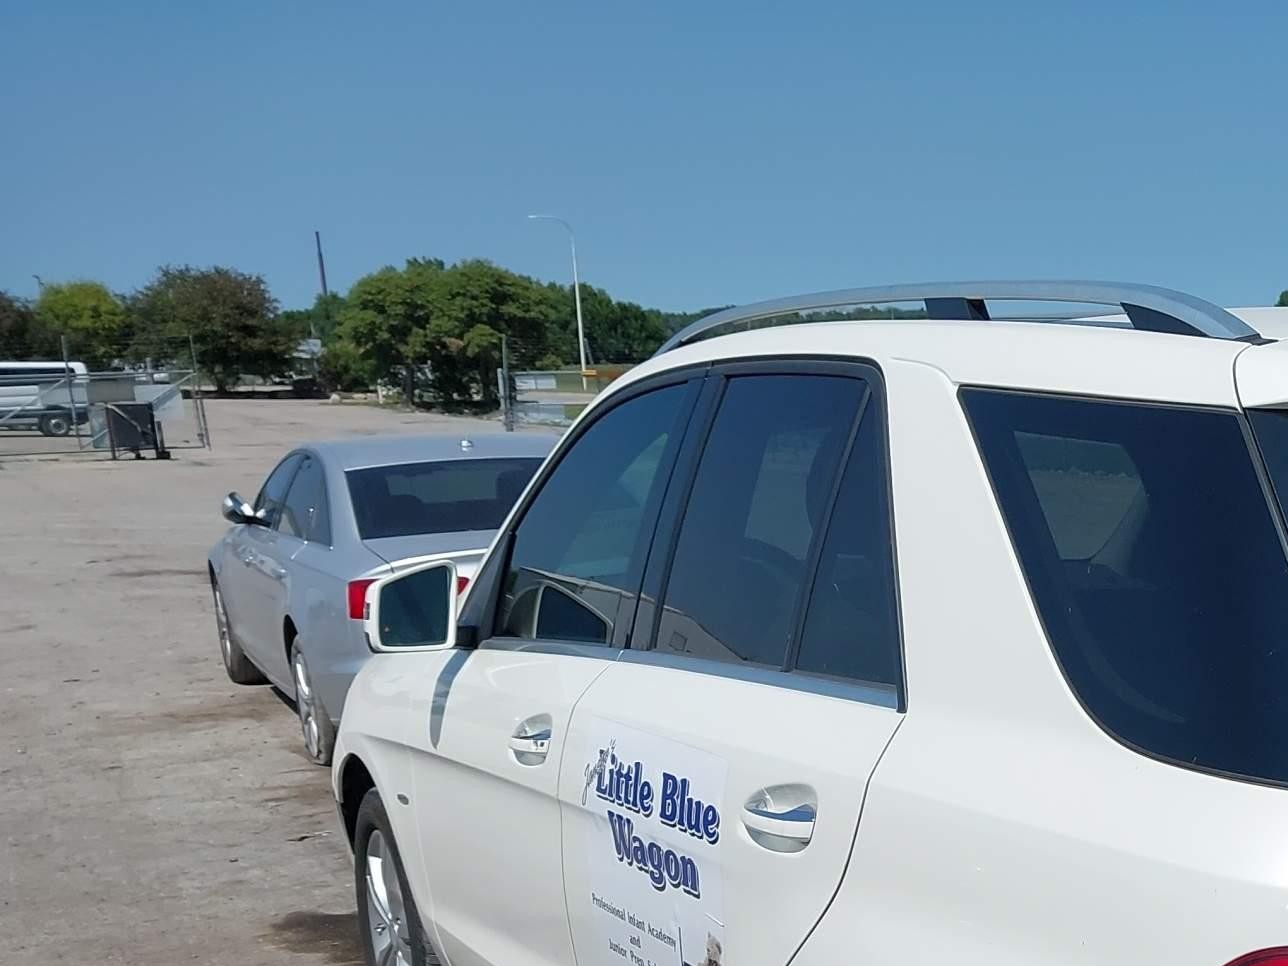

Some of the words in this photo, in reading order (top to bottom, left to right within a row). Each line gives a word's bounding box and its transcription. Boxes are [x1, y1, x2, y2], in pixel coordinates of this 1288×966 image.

[594, 752, 654, 818] Little
[659, 772, 720, 845] Blue
[607, 810, 700, 900] Wagon
[592, 893, 626, 921] Professional
[627, 911, 646, 932] Infant
[647, 923, 677, 952] Academy
[629, 935, 641, 948] and
